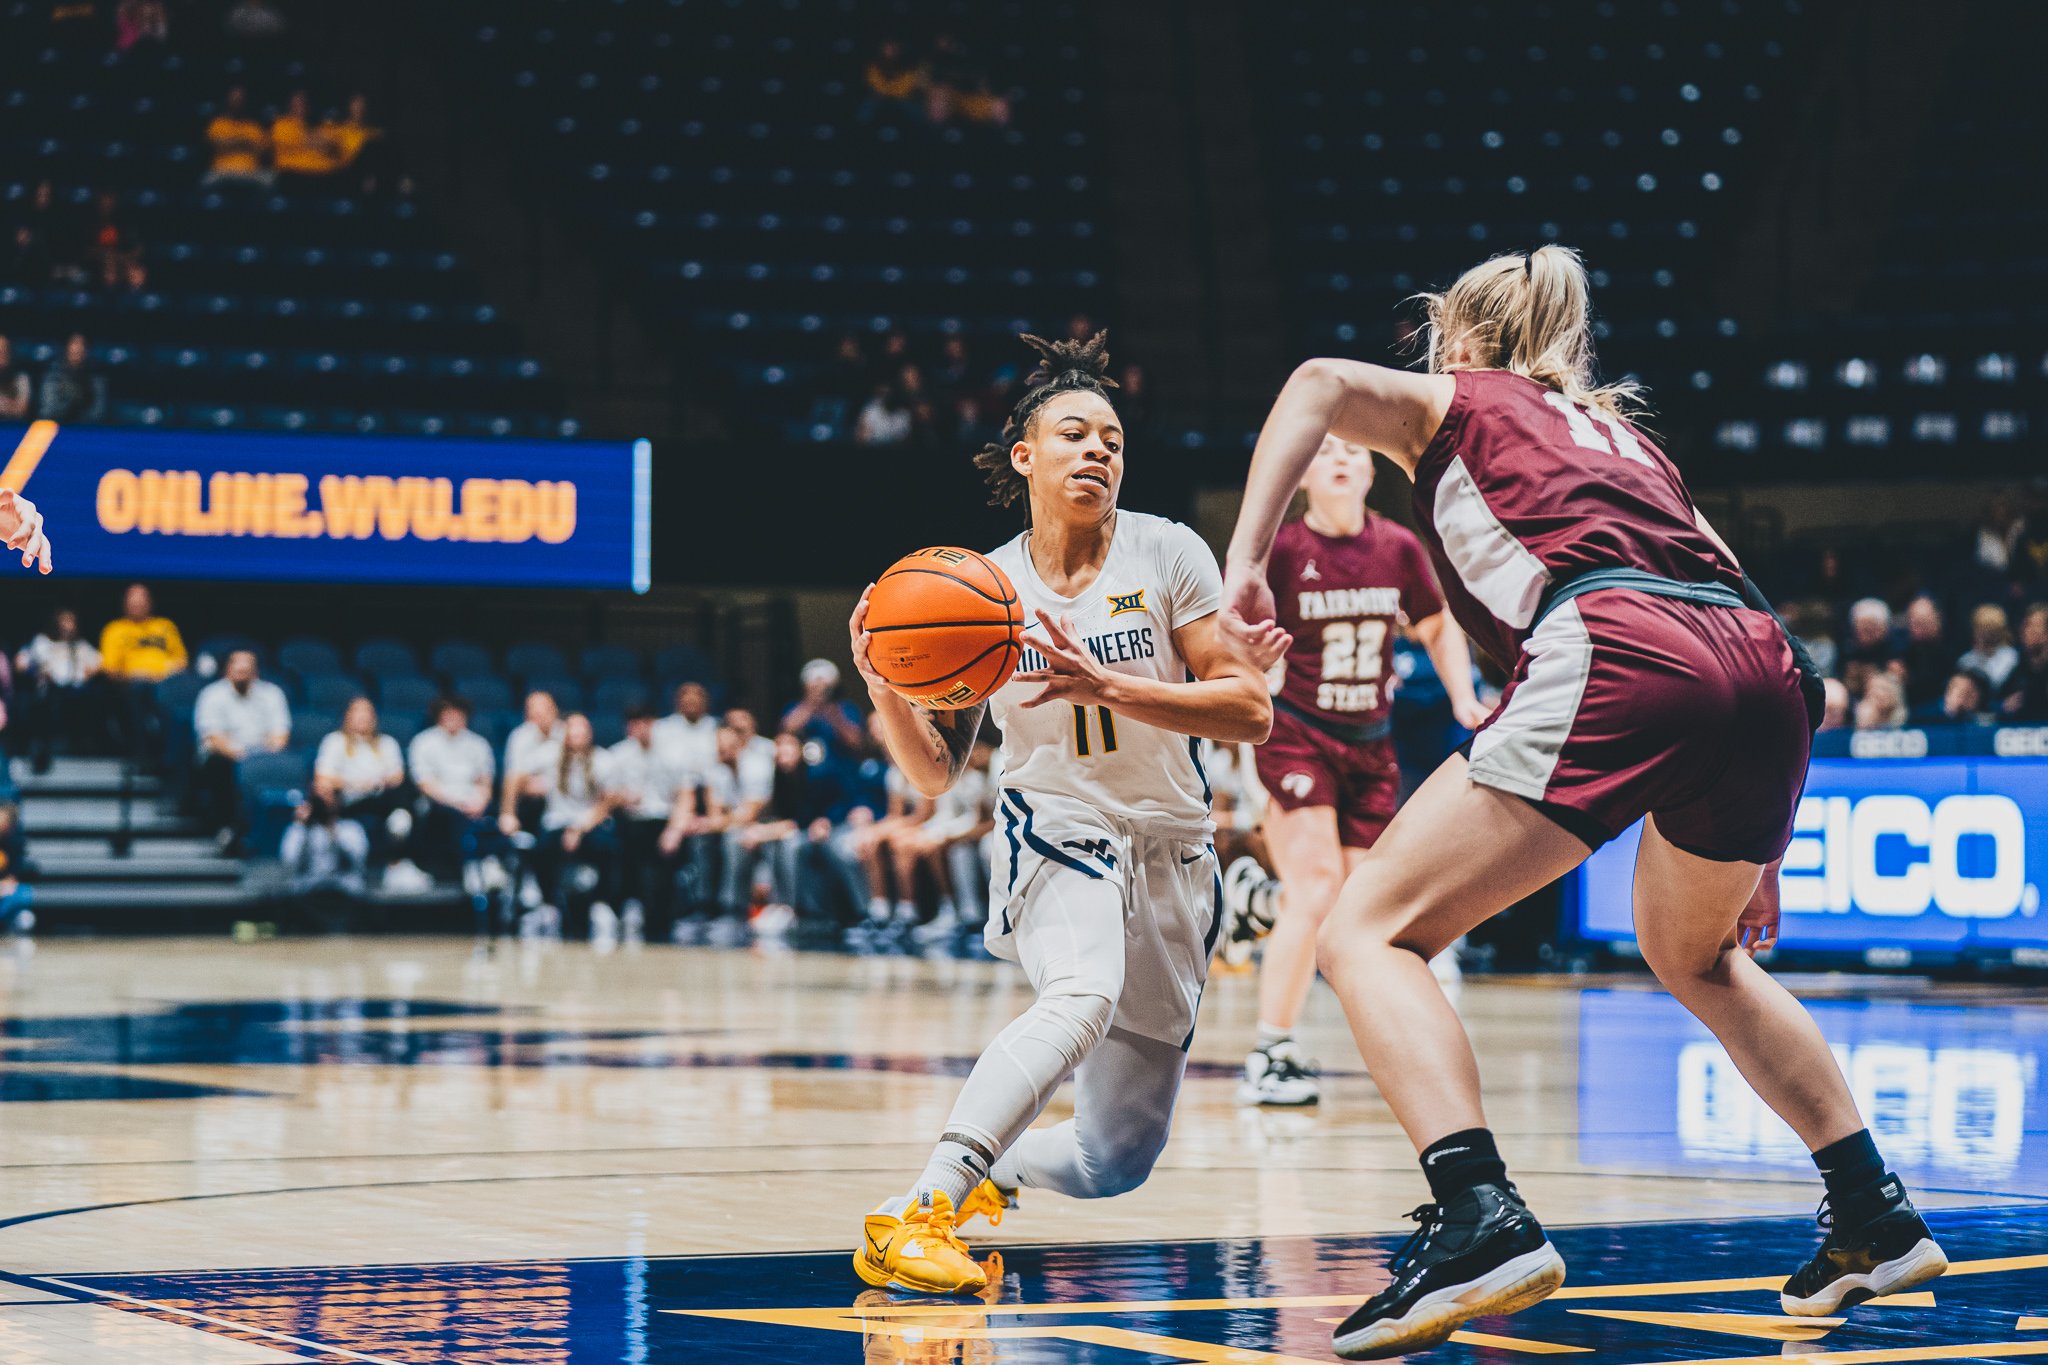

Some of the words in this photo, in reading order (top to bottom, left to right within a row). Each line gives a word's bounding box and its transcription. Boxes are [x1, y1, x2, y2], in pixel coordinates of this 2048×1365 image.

[97, 468, 577, 544] ONLINE.WVU.EDU
[1322, 620, 1387, 680] 22
[1994, 727, 2048, 757] GEIC
